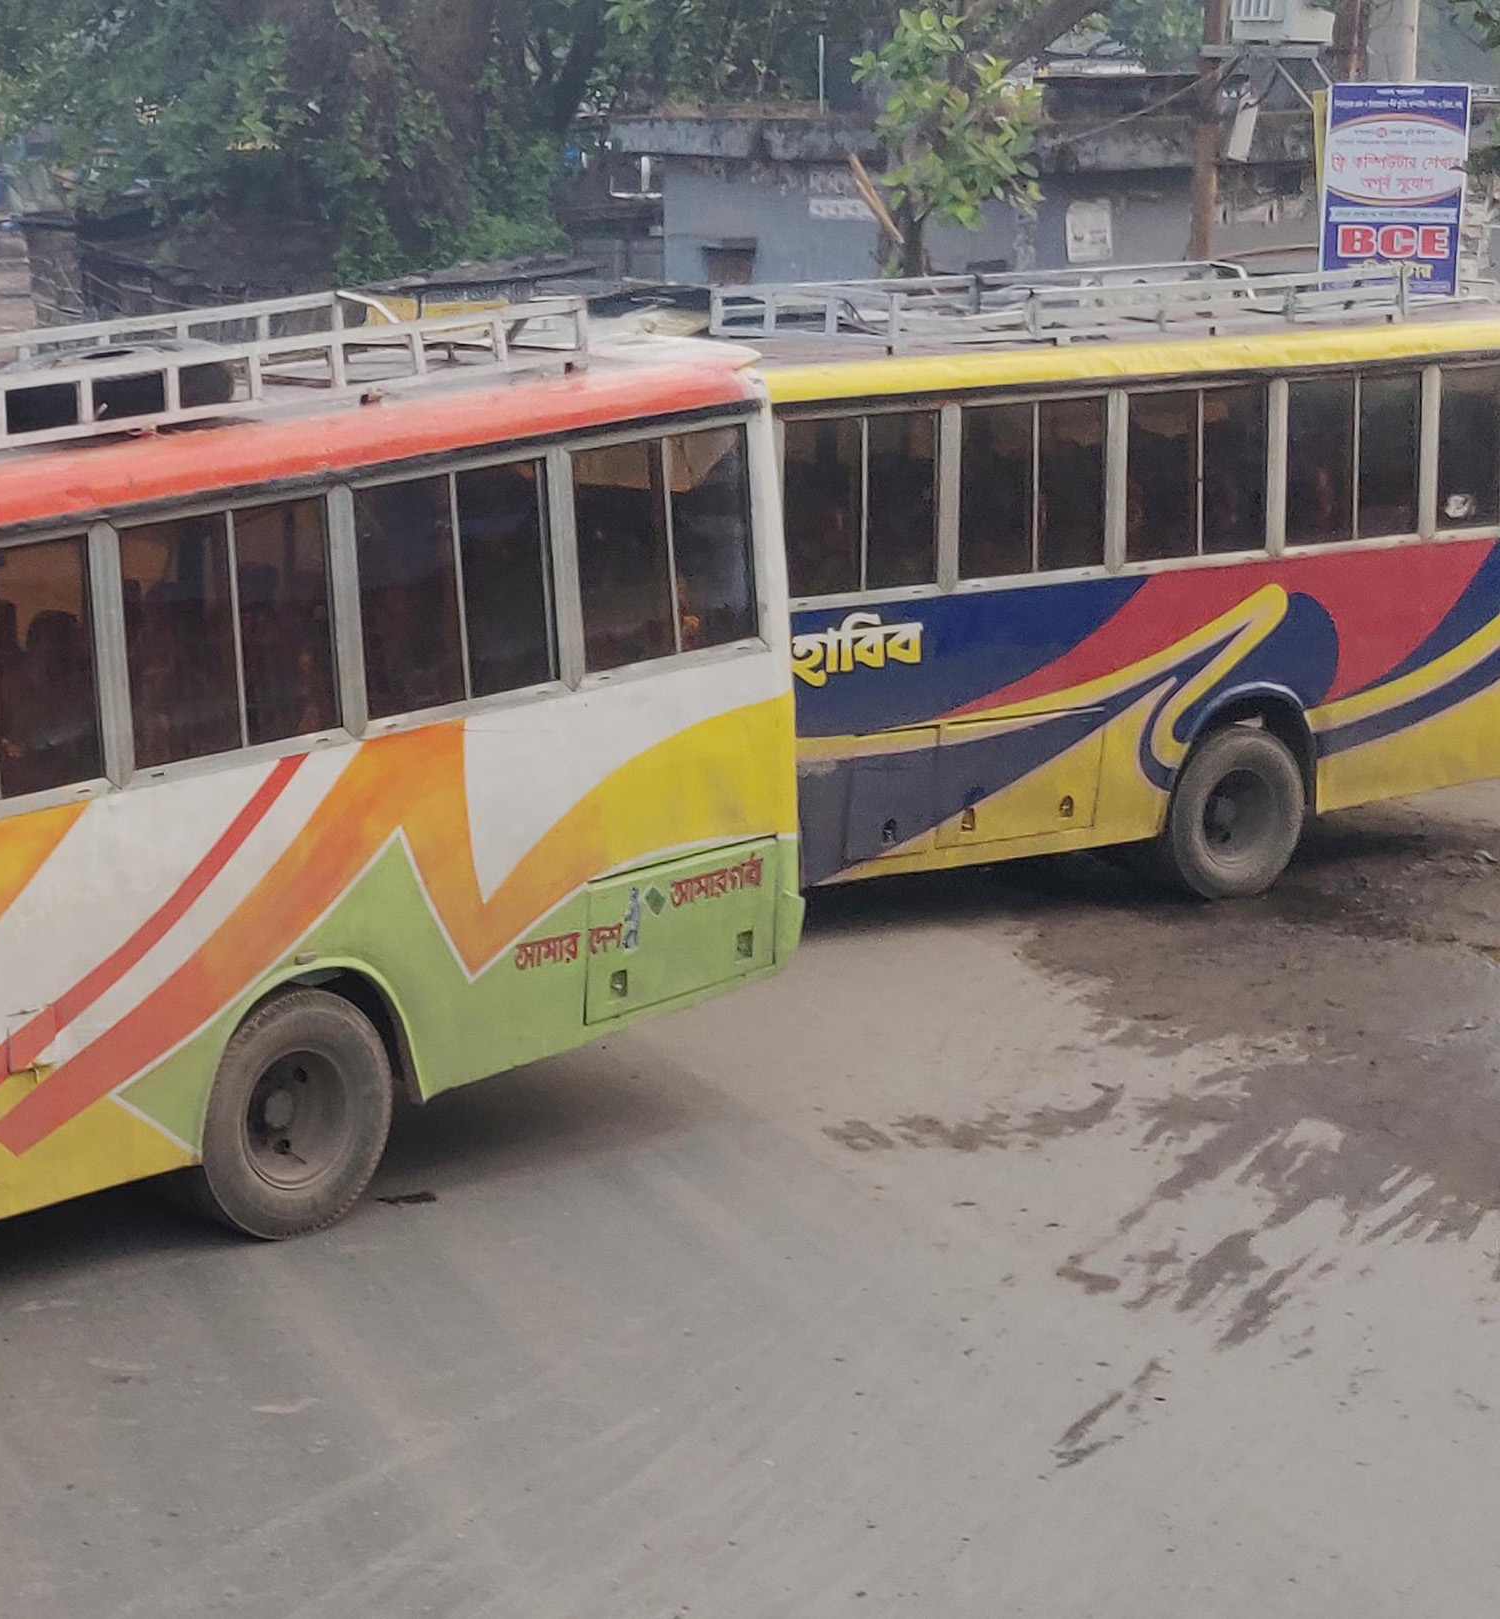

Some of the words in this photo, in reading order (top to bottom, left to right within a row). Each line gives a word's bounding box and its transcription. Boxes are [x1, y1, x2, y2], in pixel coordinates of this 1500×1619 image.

[1337, 225, 1450, 259] BCE
[792, 612, 924, 687] হাবিব
[514, 931, 581, 970] আমার
